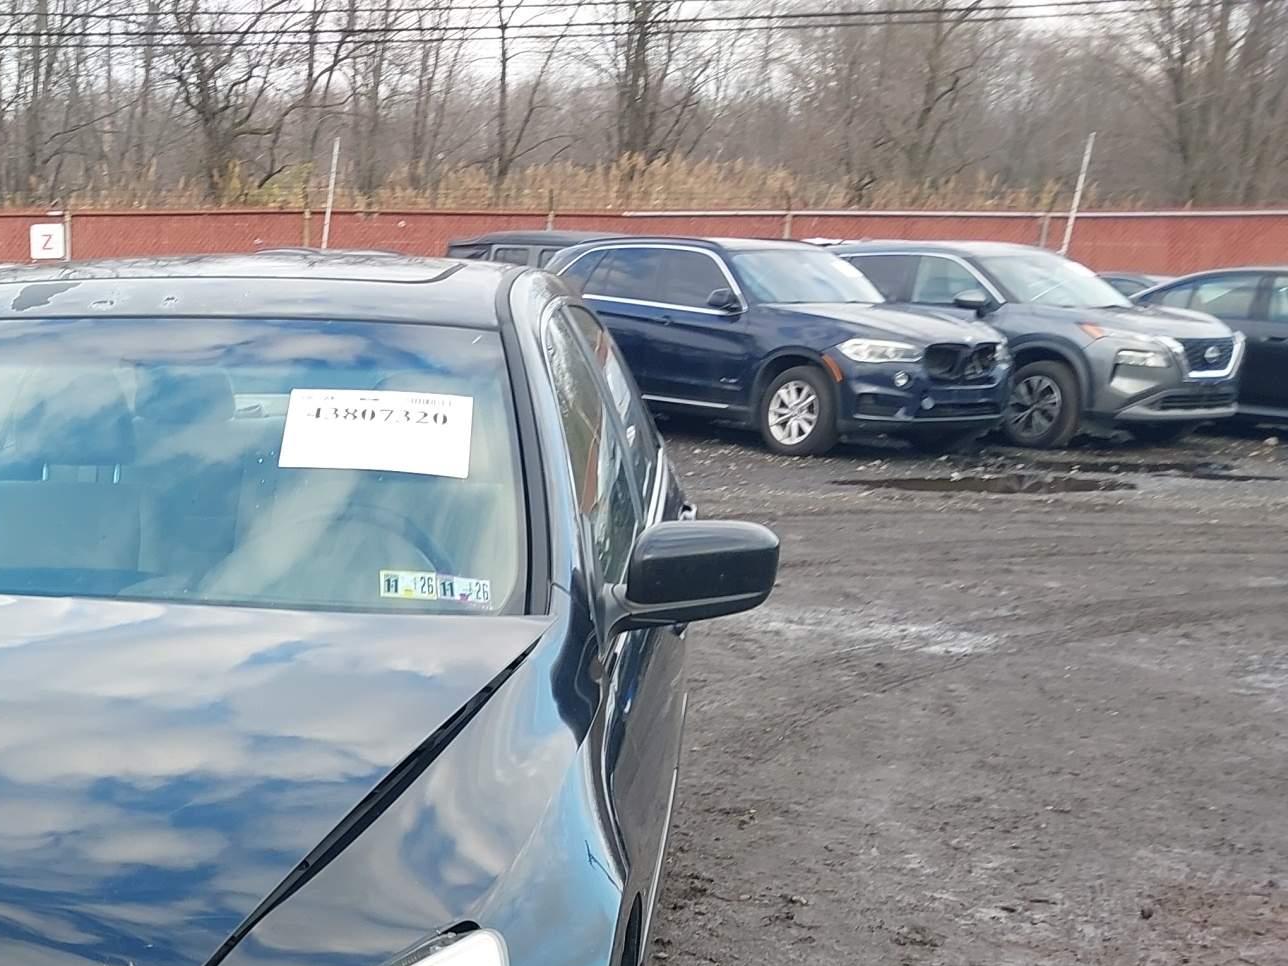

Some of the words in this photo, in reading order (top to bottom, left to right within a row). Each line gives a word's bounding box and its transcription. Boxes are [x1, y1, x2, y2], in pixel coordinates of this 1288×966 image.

[40, 233, 53, 250] Z
[384, 577, 399, 593] 11
[420, 576, 434, 595] 26
[440, 581, 455, 597] 11
[475, 581, 489, 601] 26
